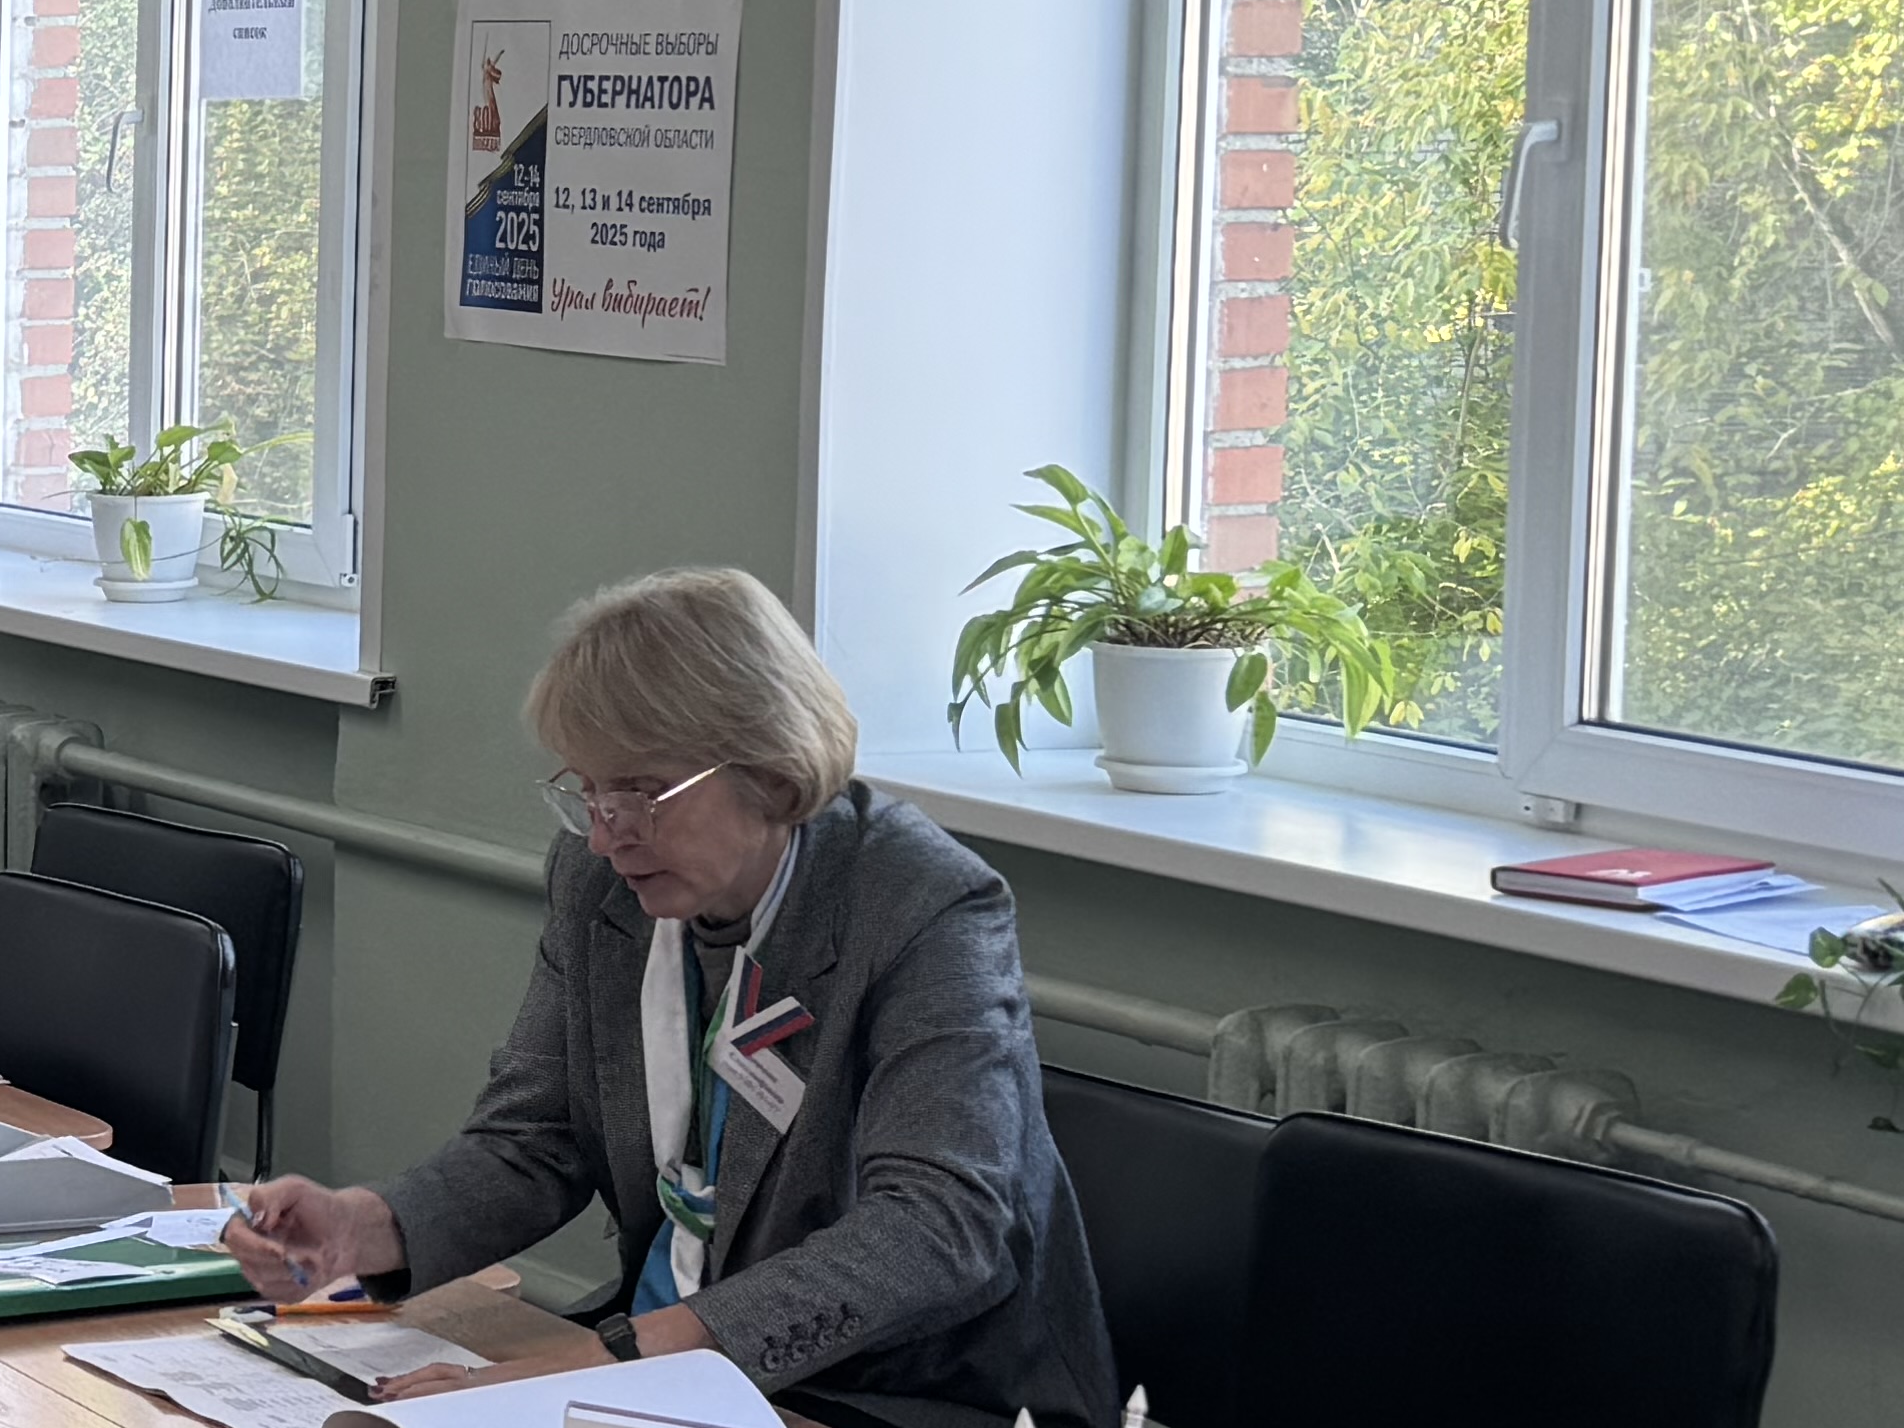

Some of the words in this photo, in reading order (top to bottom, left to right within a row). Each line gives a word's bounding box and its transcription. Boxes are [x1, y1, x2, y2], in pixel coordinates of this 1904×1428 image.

[558, 32, 651, 61] ДОСРОЧНЫЕ
[654, 31, 720, 56] ВЫБОРЫ
[556, 74, 716, 111] ГУБЕРНАТОРА
[554, 123, 650, 151] СВЕРДЛОВСКОЙ
[653, 127, 715, 150] ОБЛАСТИ
[513, 163, 541, 188] 12-14
[554, 186, 575, 214] 12,
[580, 187, 598, 211] 13
[601, 194, 611, 211] и
[615, 190, 634, 212] 14
[638, 192, 712, 221] сентября
[495, 211, 540, 252] 2025
[590, 222, 628, 247] 2025
[632, 229, 666, 253] года
